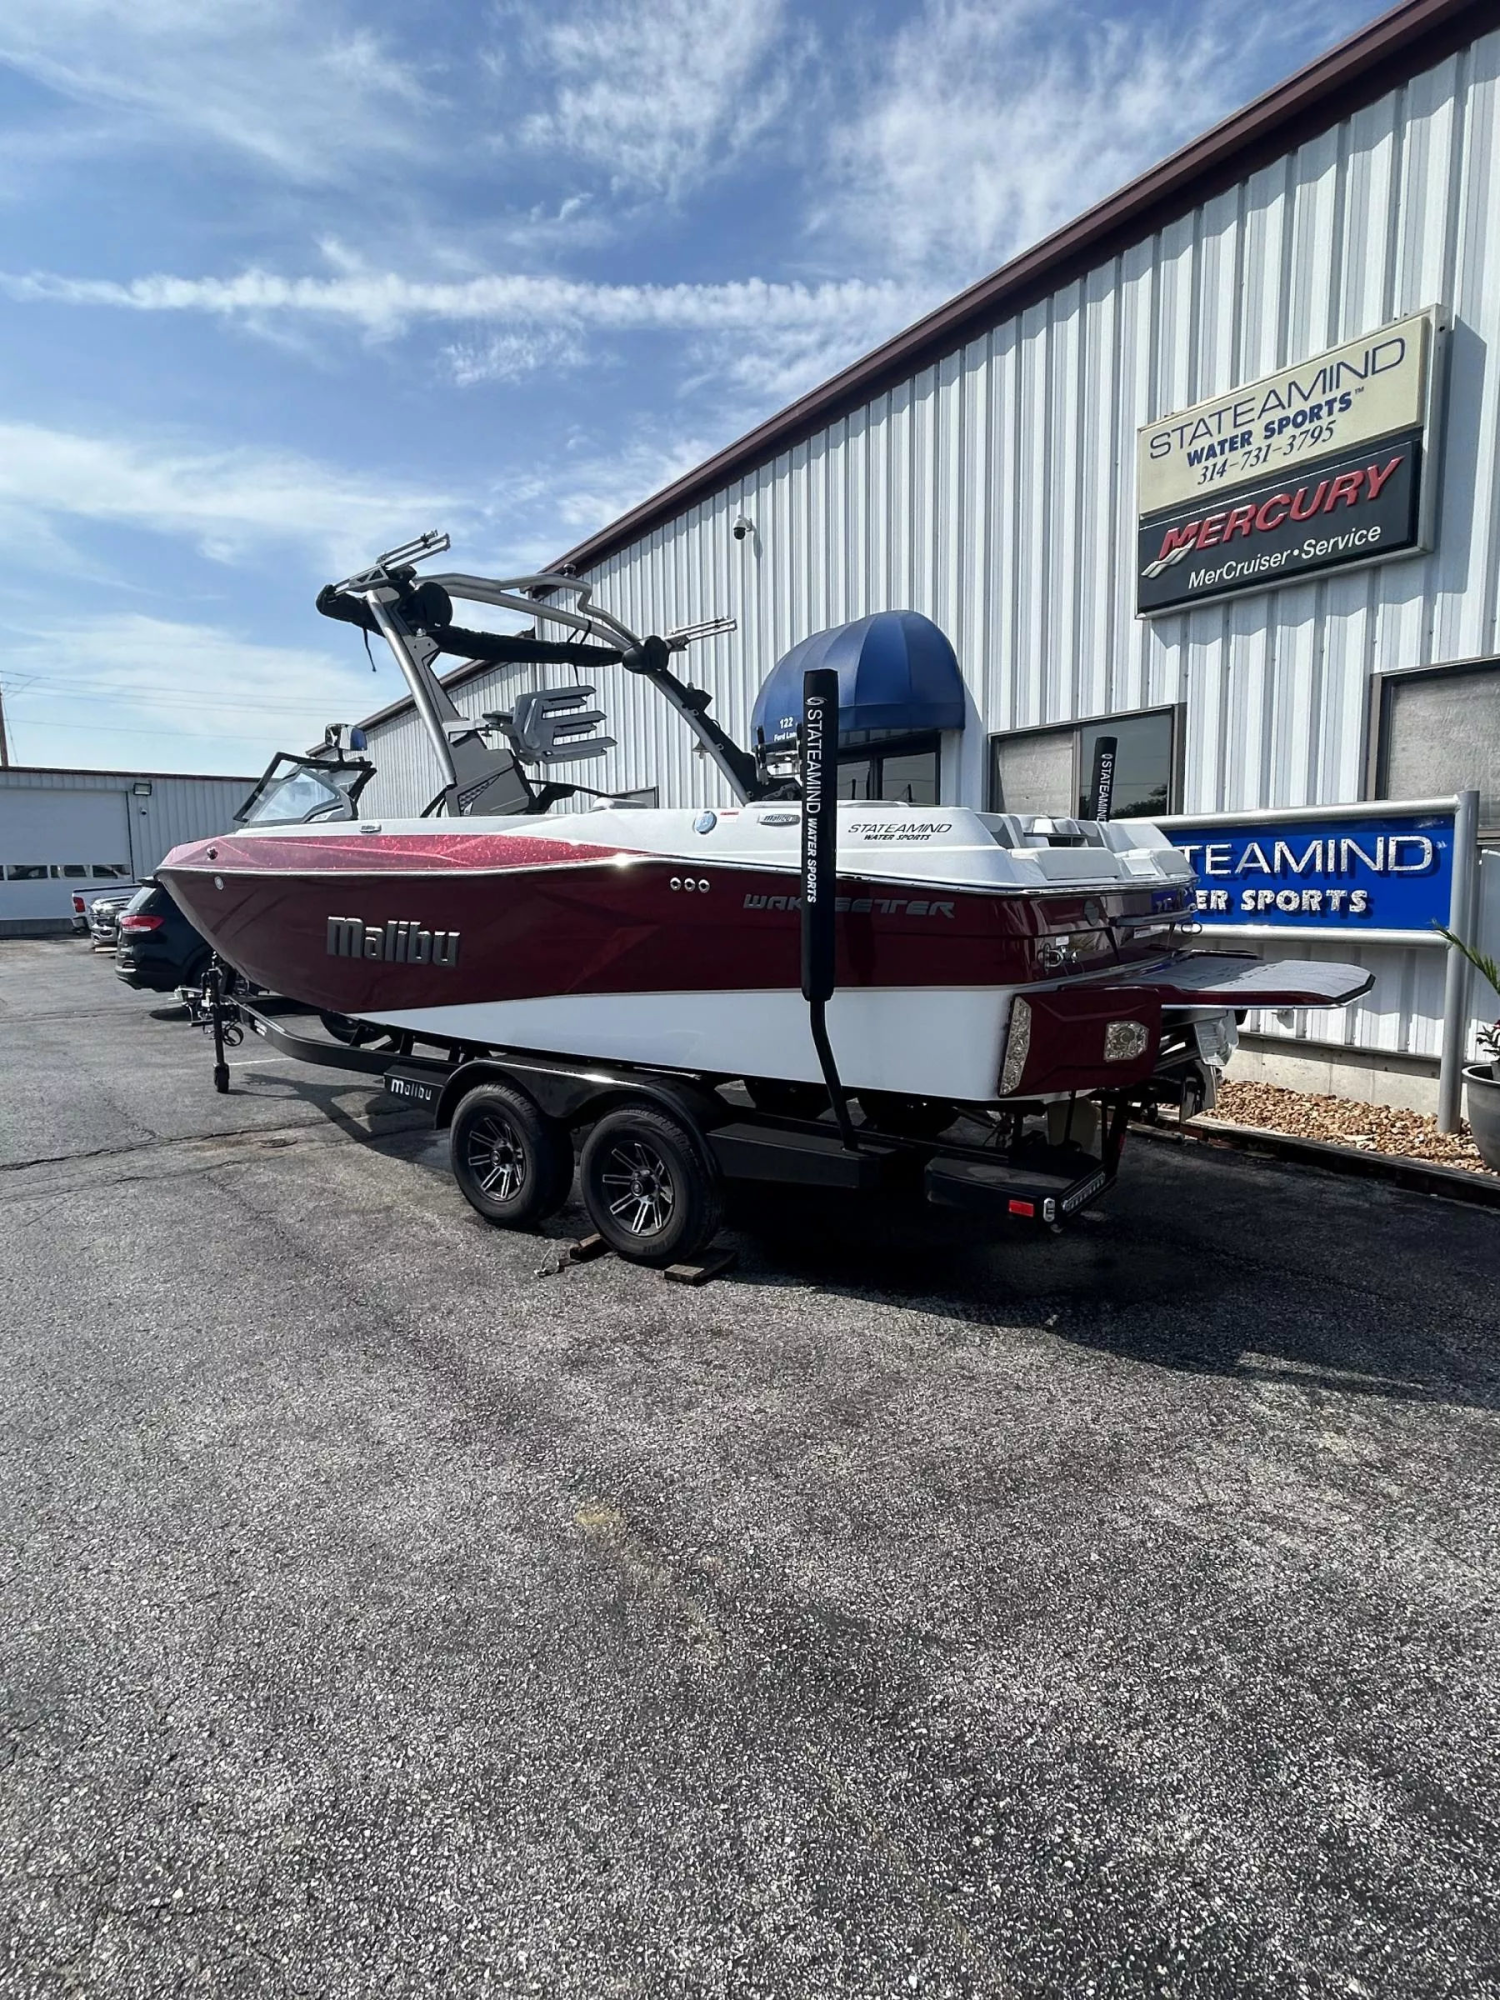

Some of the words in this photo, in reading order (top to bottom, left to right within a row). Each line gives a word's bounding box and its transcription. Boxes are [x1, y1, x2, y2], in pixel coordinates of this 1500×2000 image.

[1150, 337, 1406, 460] STATEAMIND
[1187, 430, 1254, 467] WATER
[1264, 391, 1352, 440] SPORTS
[1197, 420, 1337, 486] 314-731-3795
[1158, 455, 1405, 561] MERCURY
[780, 717, 793, 729] 122
[806, 708, 822, 814] STATEAMIND
[807, 818, 818, 857] WATER
[848, 823, 953, 833] STATEAMIND
[1174, 836, 1432, 875] TEAMIND
[806, 859, 817, 903] SPORTS
[1241, 888, 1368, 913] SPORTS
[744, 894, 955, 918] WAKSETTER
